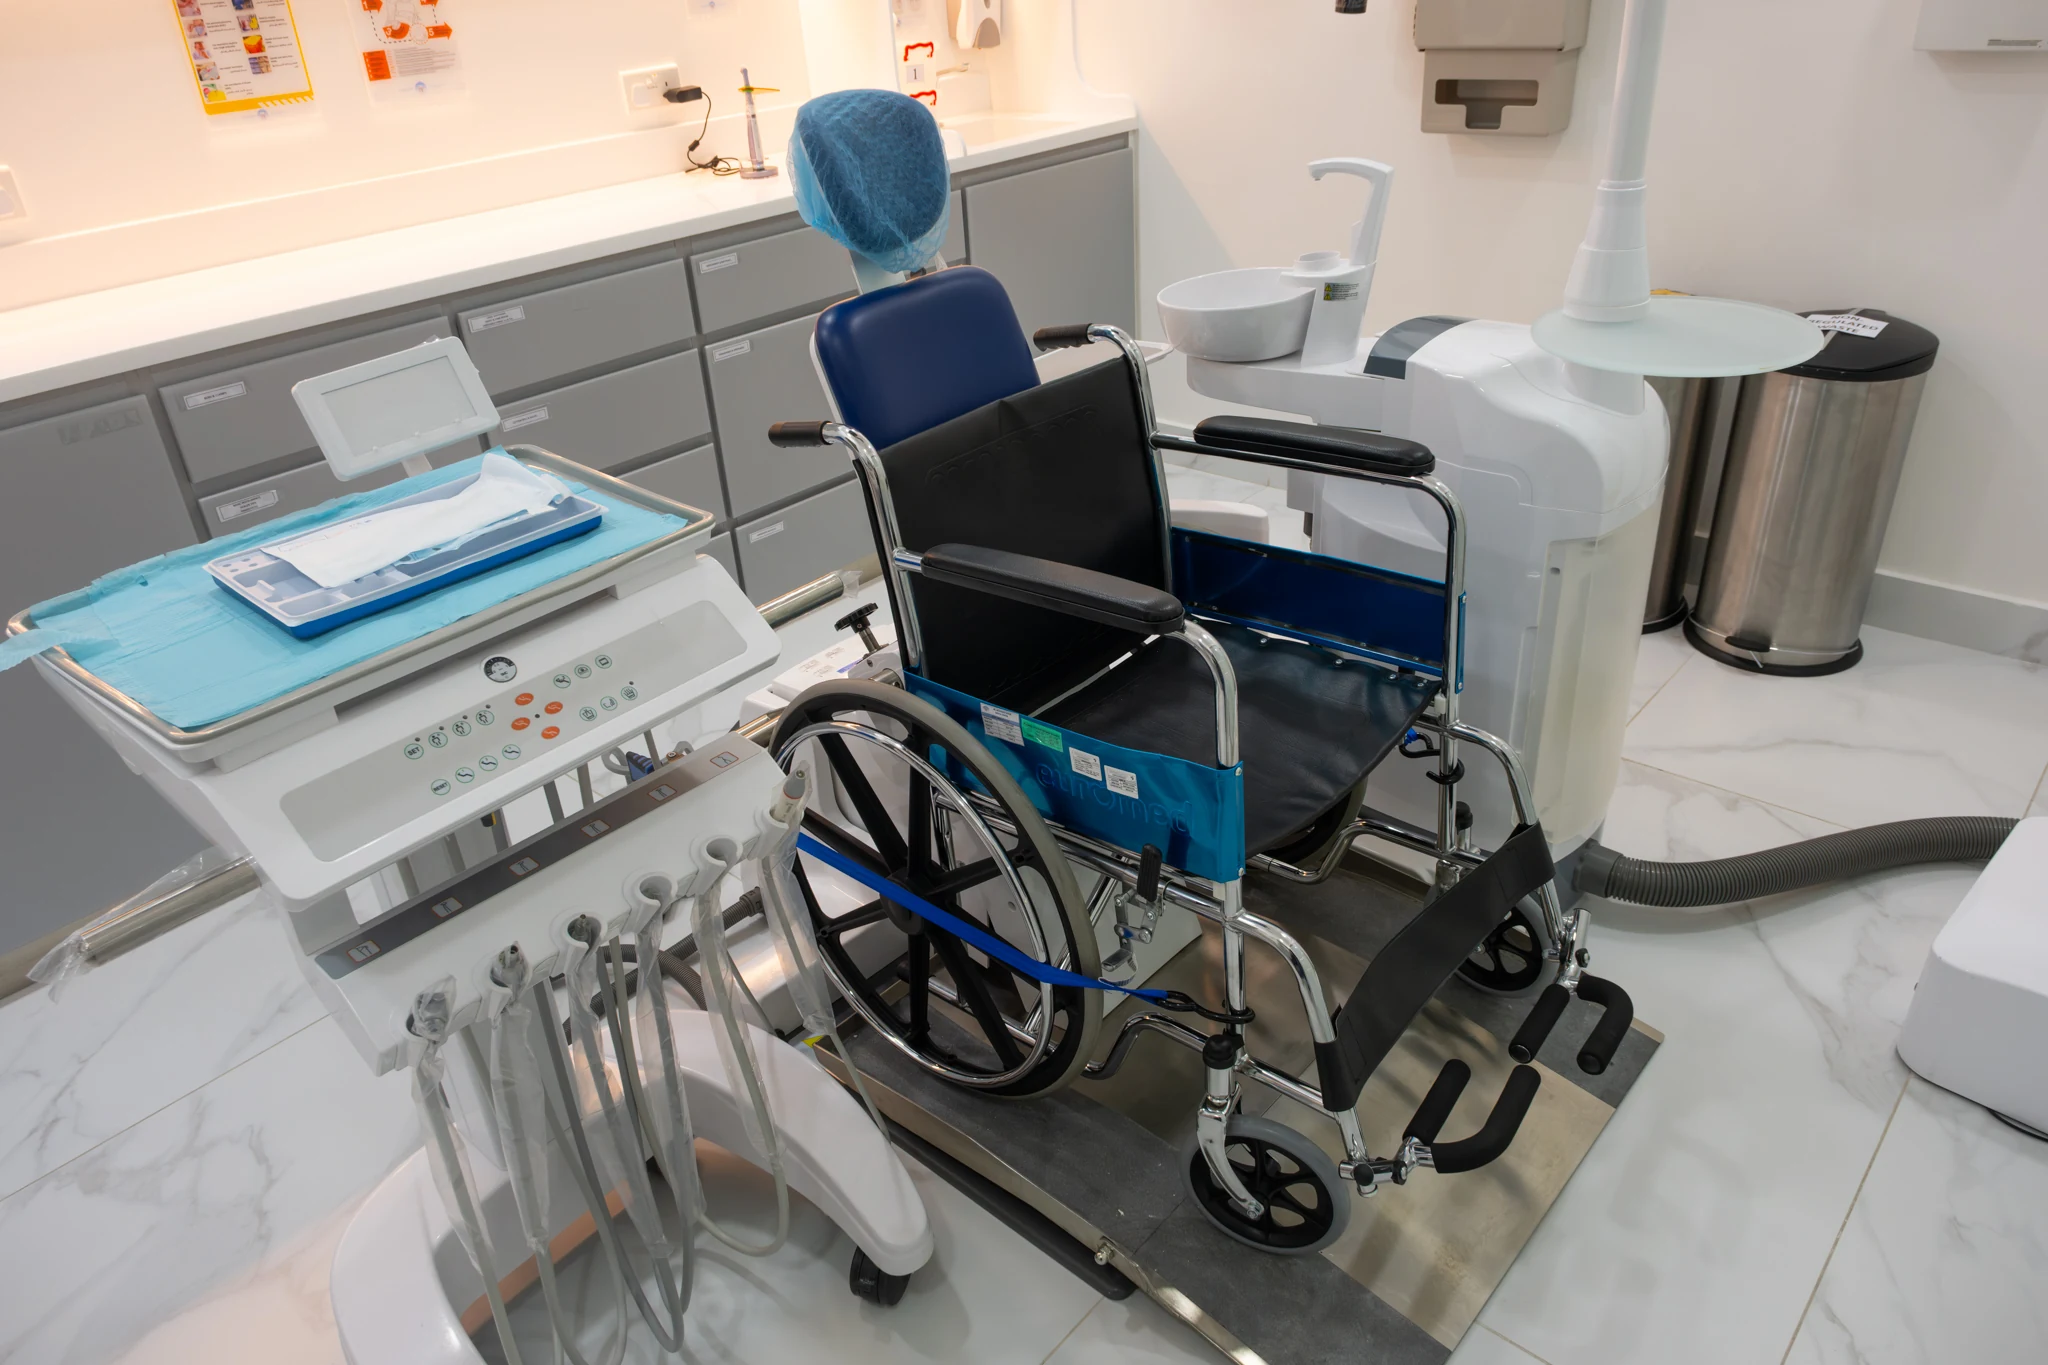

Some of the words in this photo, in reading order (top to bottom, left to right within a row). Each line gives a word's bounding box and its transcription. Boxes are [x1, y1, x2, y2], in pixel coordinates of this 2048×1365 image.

[385, 28, 392, 36] 3
[428, 28, 434, 36] 5
[1817, 324, 1860, 333] WASTE
[407, 746, 420, 756] SET
[433, 782, 448, 792] RESET
